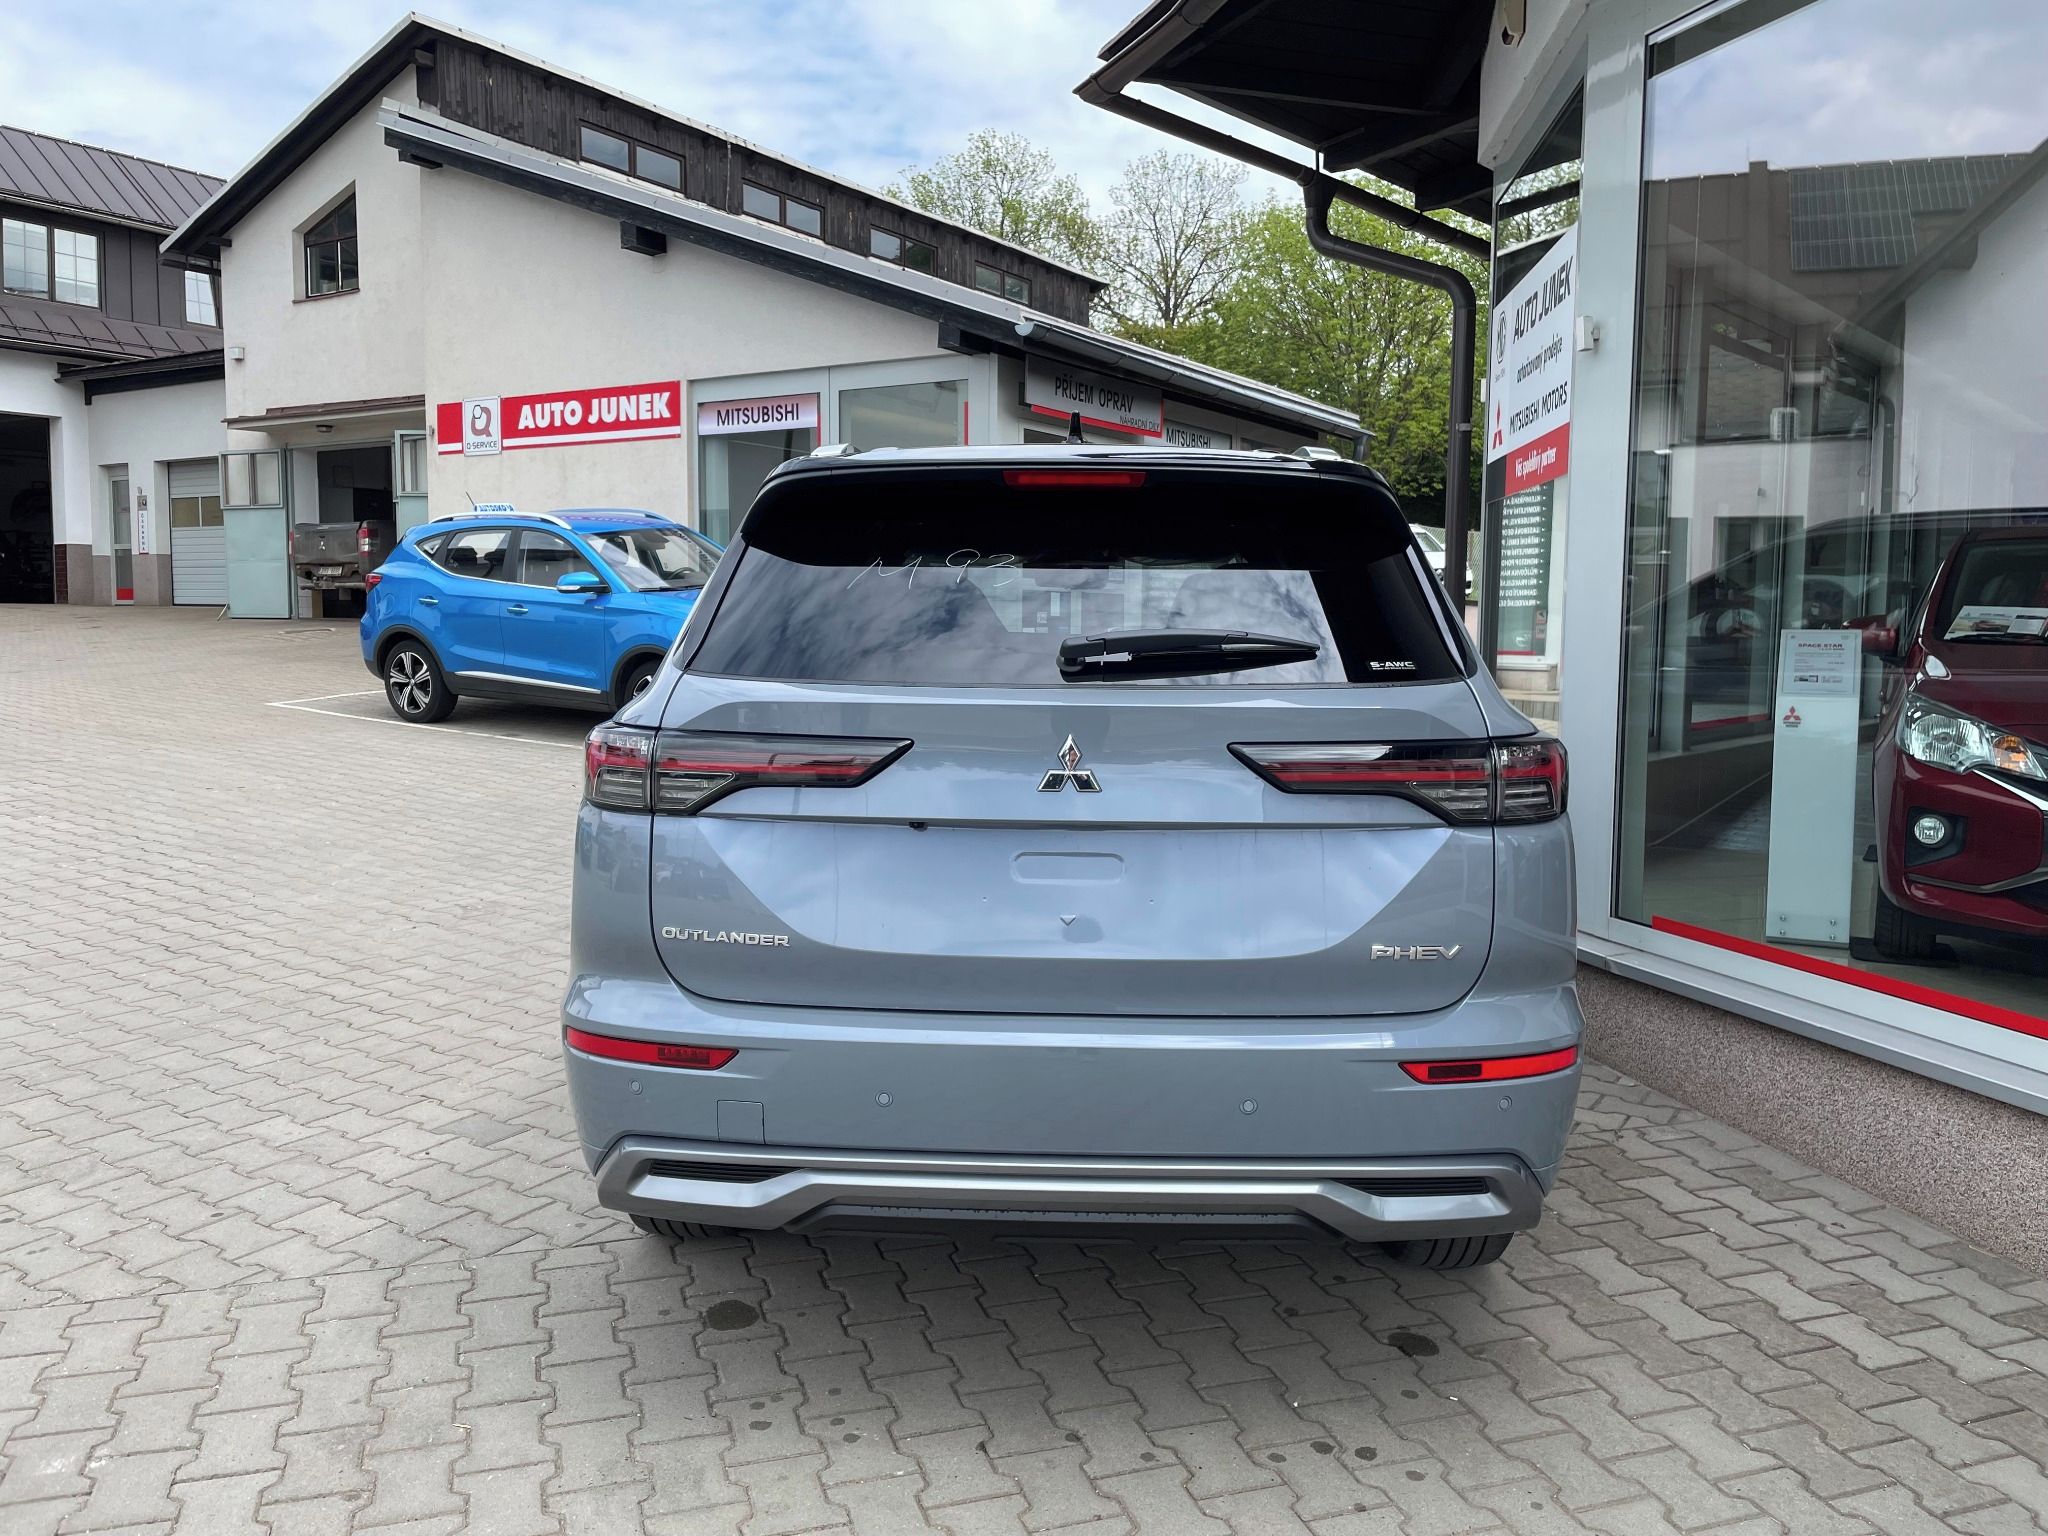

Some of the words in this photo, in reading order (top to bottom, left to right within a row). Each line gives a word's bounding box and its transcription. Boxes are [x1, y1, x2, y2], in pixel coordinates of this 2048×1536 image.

[1512, 291, 1538, 345] AUTO
[1538, 255, 1573, 322] JUNEK
[1543, 333, 1562, 372] prodejce
[1055, 373, 1094, 405] PŘÍJEM
[1099, 389, 1134, 414] OPRAV
[1510, 399, 1540, 436] MITSUBISHI
[1541, 380, 1567, 418] MOTORS
[517, 400, 582, 430] AUTO
[588, 391, 672, 425] JUNEK
[716, 402, 800, 427] MITSUBISHI
[1166, 427, 1211, 449] MITSUBISHI
[1540, 446, 1556, 474] partner
[661, 926, 791, 947] OUTLANDER
[1370, 944, 1463, 961] PHEV
